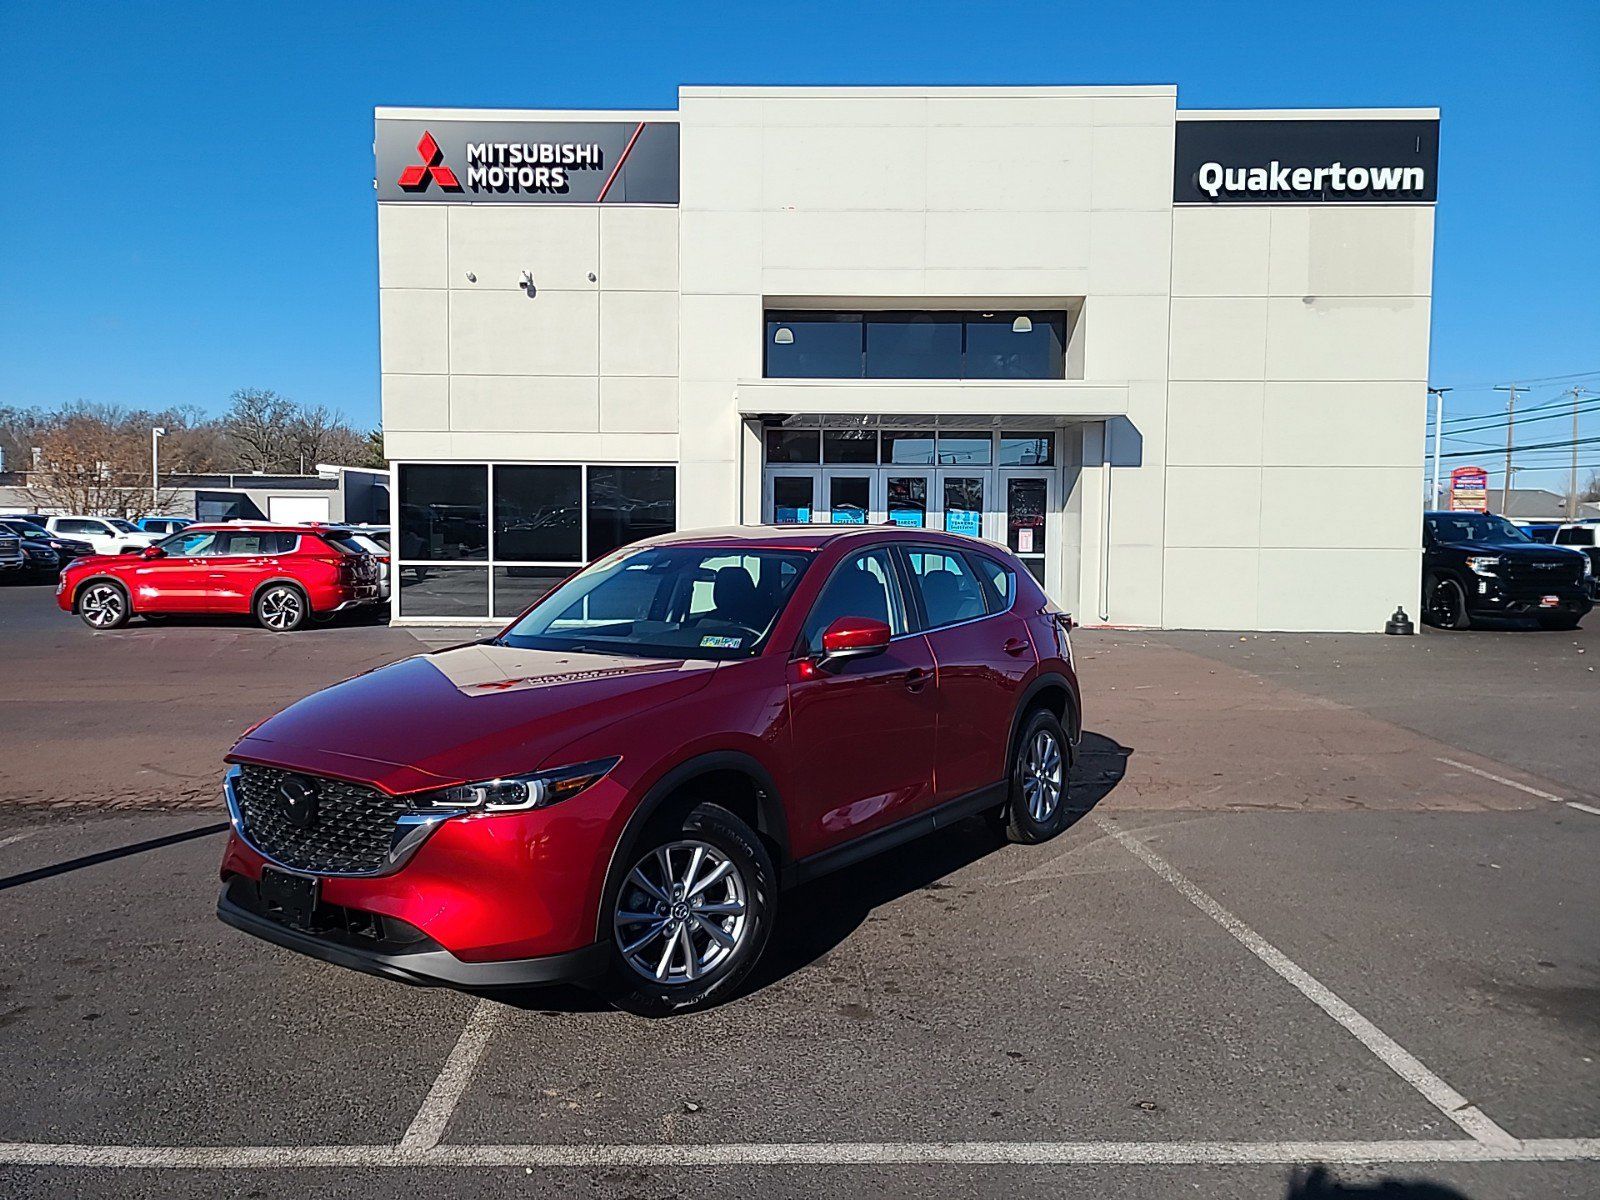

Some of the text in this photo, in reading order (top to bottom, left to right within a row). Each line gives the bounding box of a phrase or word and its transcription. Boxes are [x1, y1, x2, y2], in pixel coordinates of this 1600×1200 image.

[466, 143, 599, 163] MITSUBISHI
[466, 167, 565, 187] MOTORS
[1199, 160, 1425, 197] Quakertown
